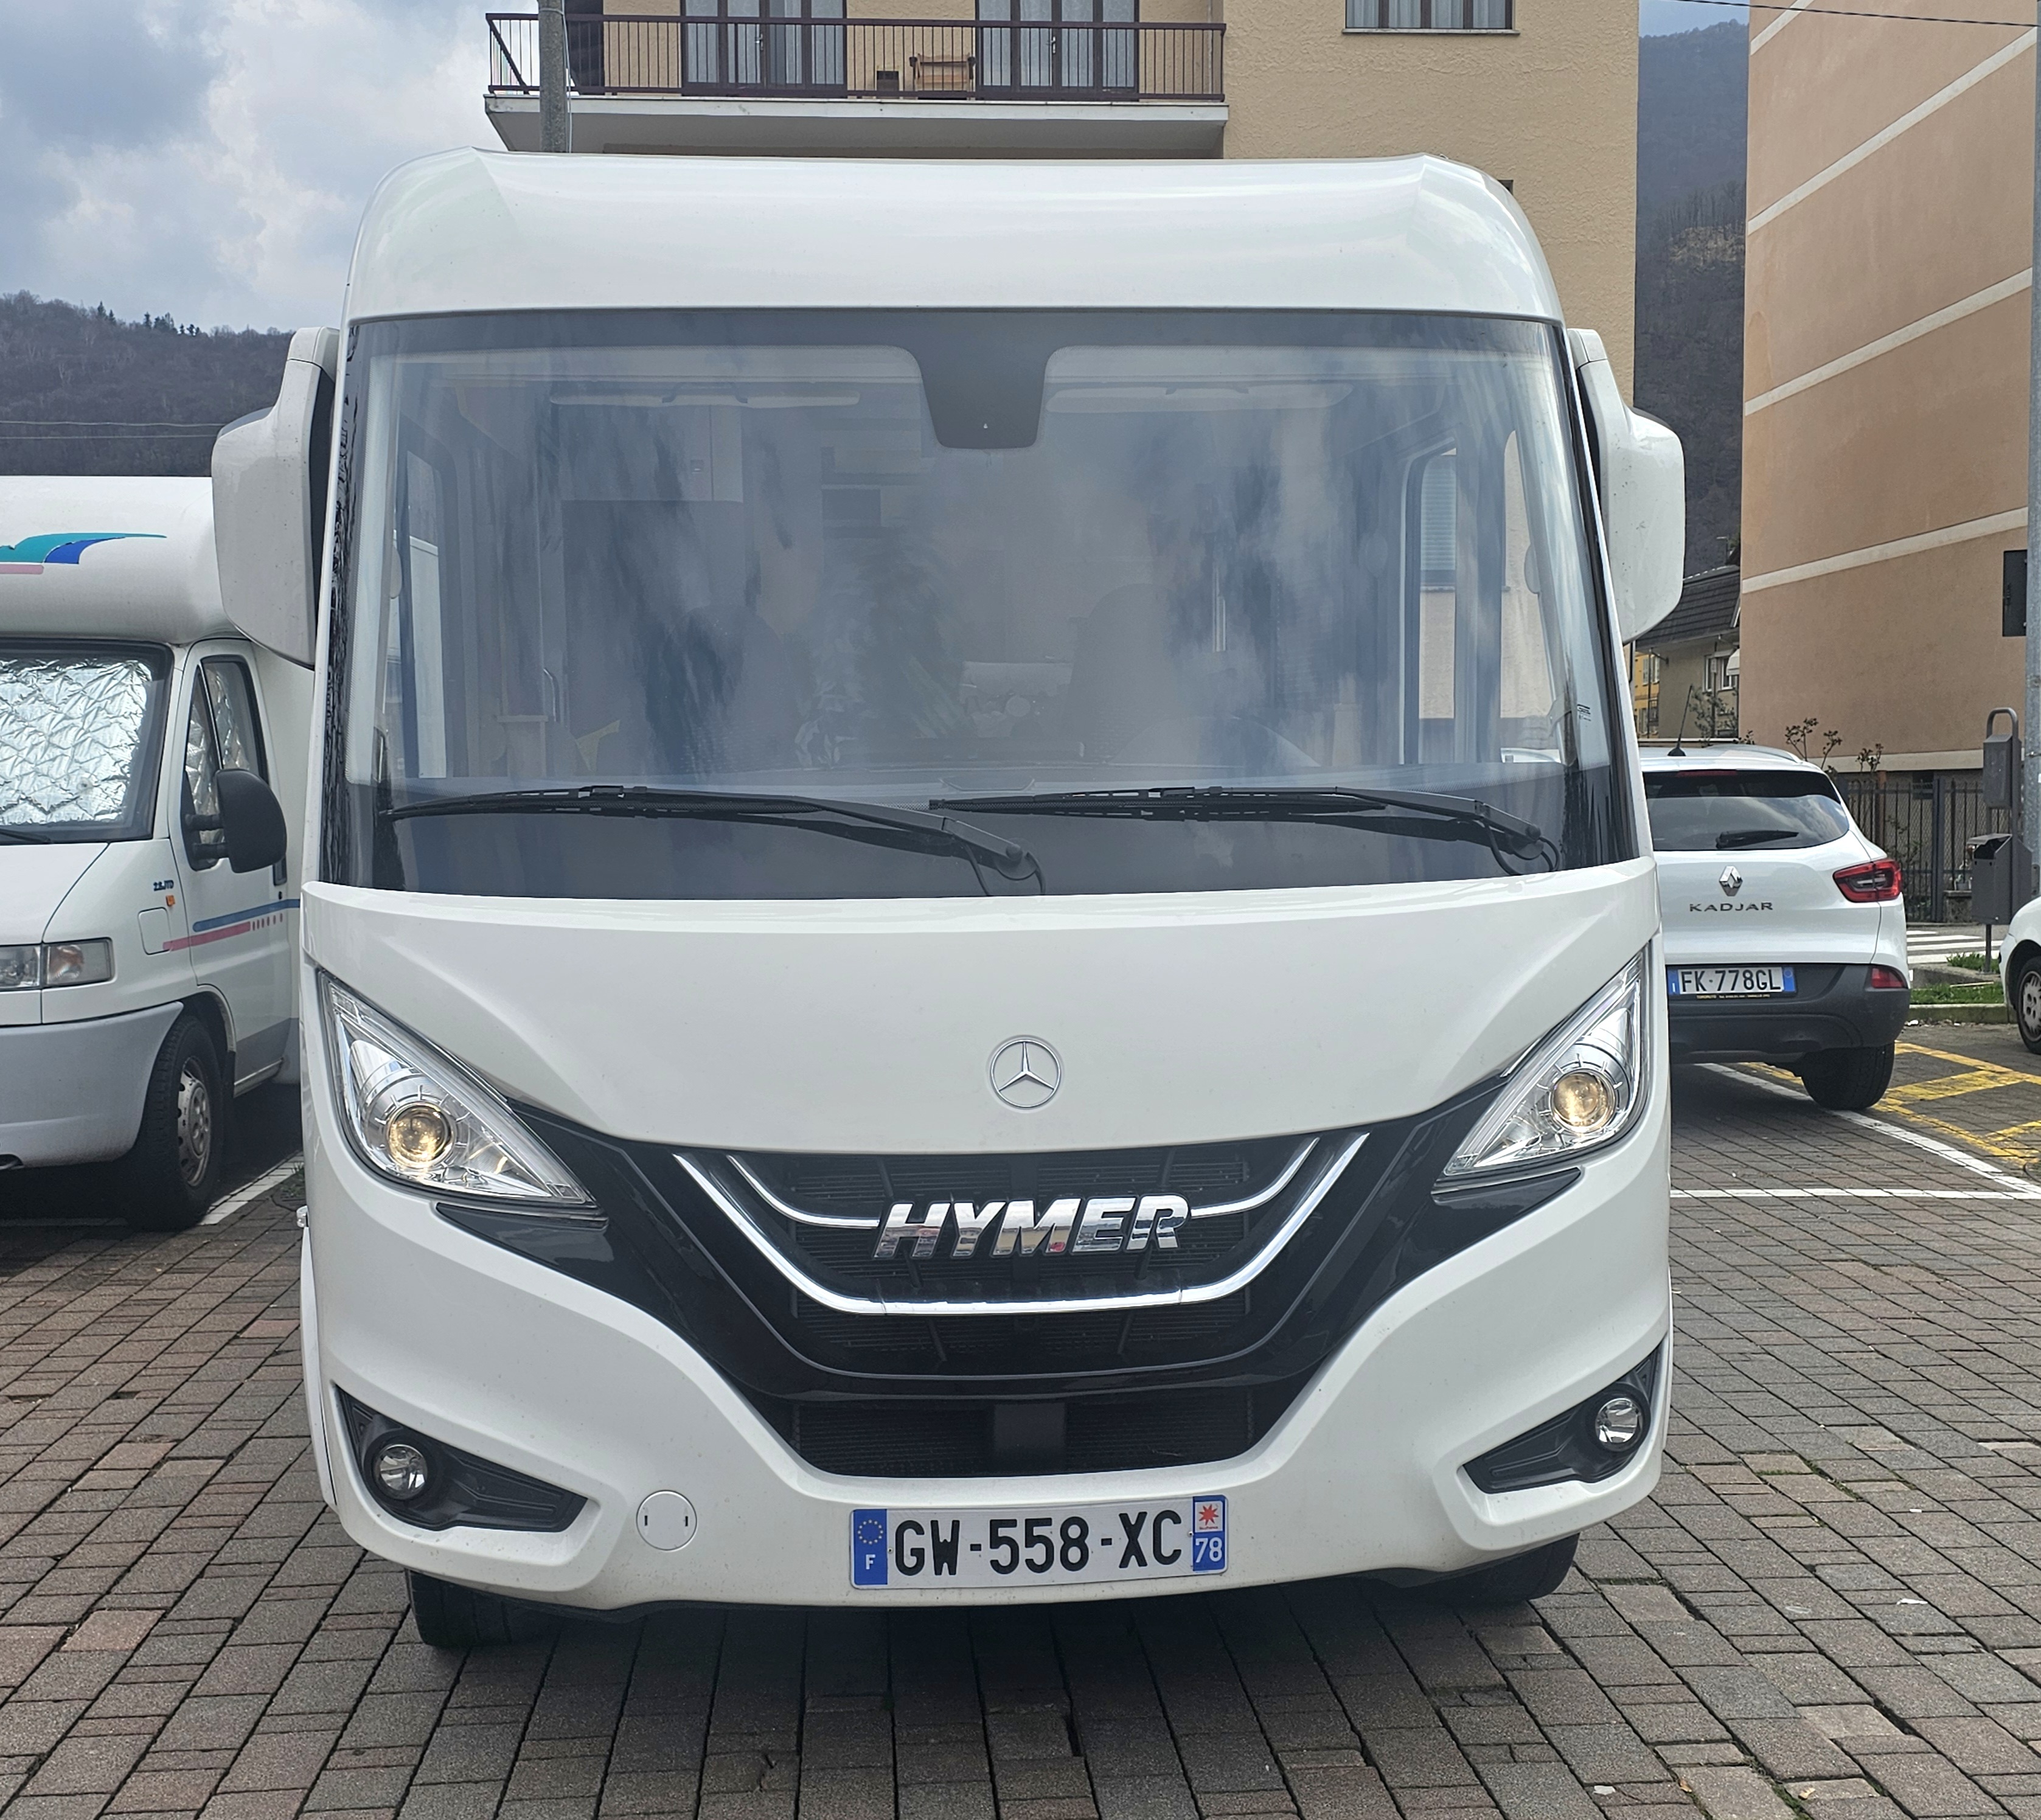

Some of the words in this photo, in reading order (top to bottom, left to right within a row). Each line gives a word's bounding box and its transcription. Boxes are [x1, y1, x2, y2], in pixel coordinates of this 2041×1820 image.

[1689, 902, 1773, 912] KADJAR
[872, 1194, 1191, 1259] HYMER
[895, 1509, 1182, 1576] GW-558-XC
[1195, 1537, 1223, 1563] 78
[865, 1554, 876, 1570] F
